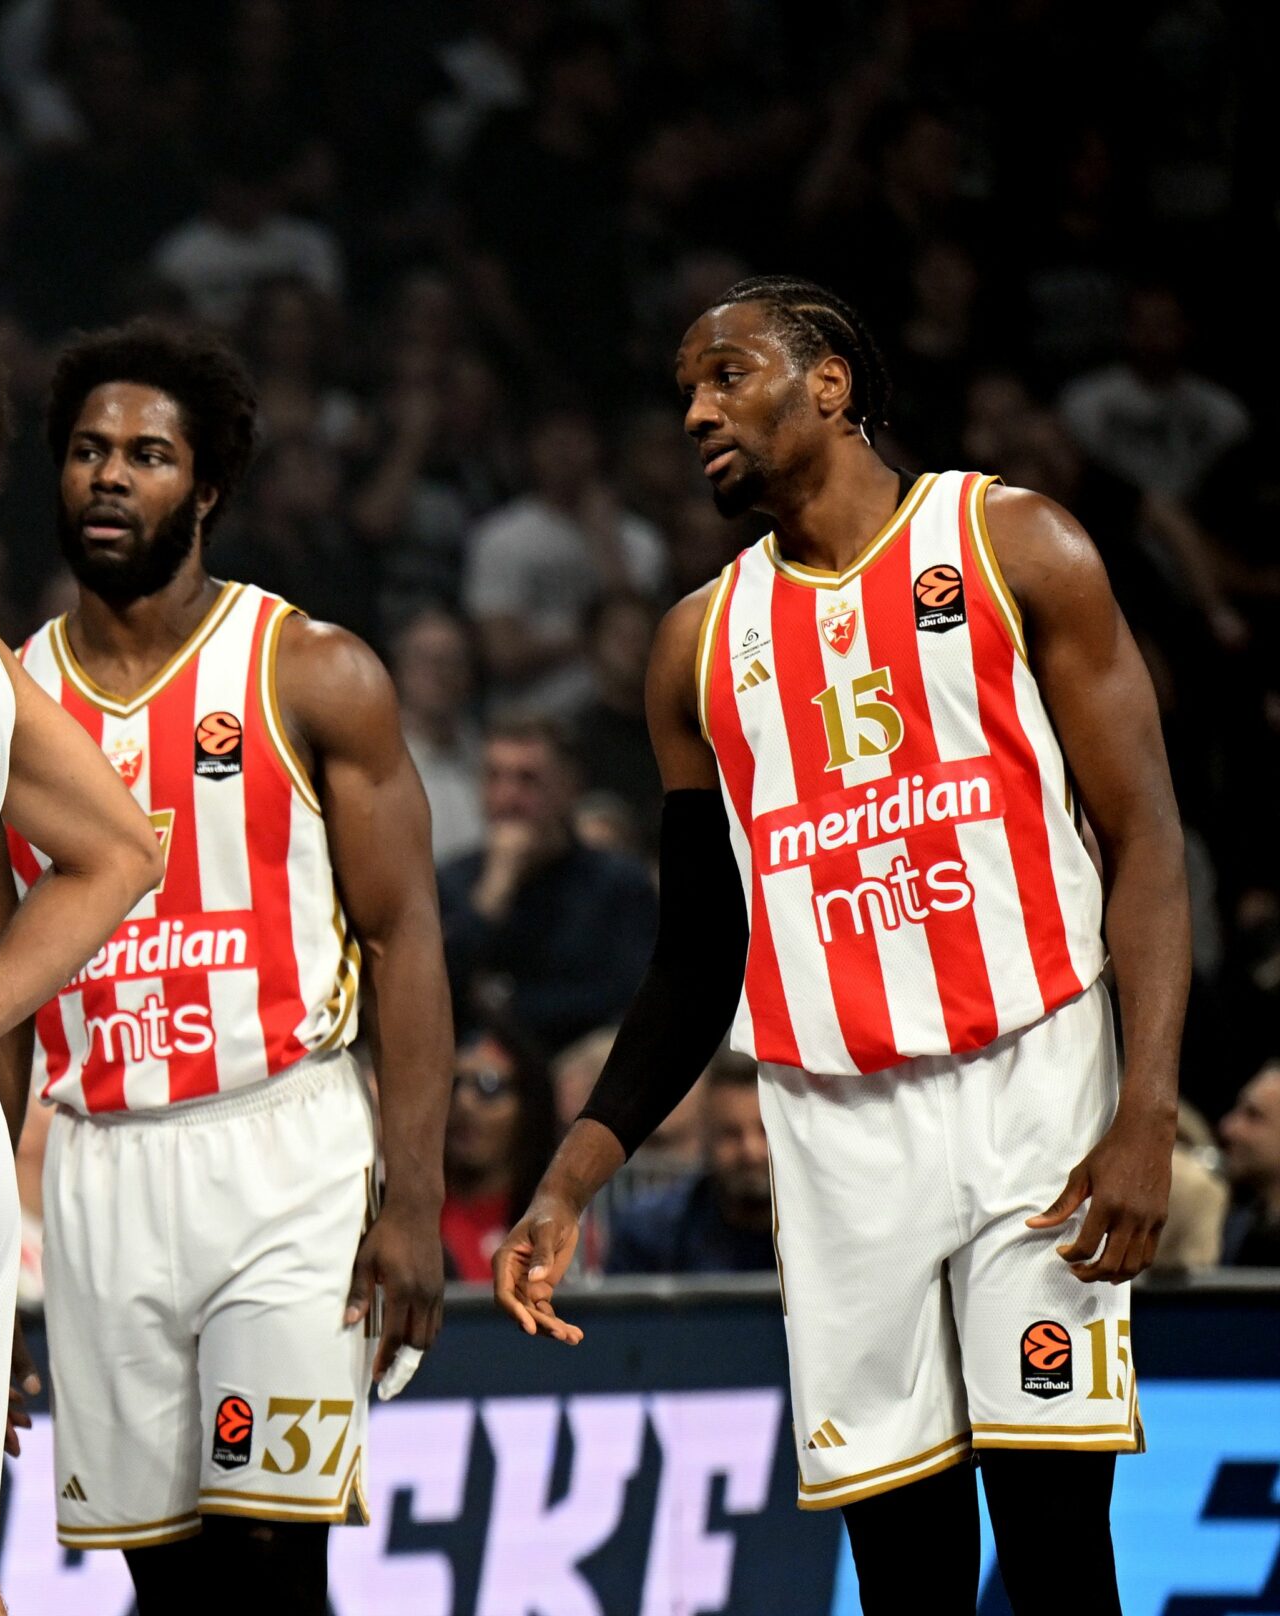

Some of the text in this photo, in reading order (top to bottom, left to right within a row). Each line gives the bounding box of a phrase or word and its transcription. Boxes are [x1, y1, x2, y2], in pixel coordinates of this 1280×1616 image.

[937, 613, 963, 624] dhabi
[810, 667, 904, 773] 15
[768, 774, 992, 867] meridian
[814, 858, 973, 945] mts
[81, 997, 215, 1066] mts
[1024, 1381, 1070, 1389] abu dhabi
[1082, 1318, 1130, 1401] 15
[261, 1397, 354, 1476] 37
